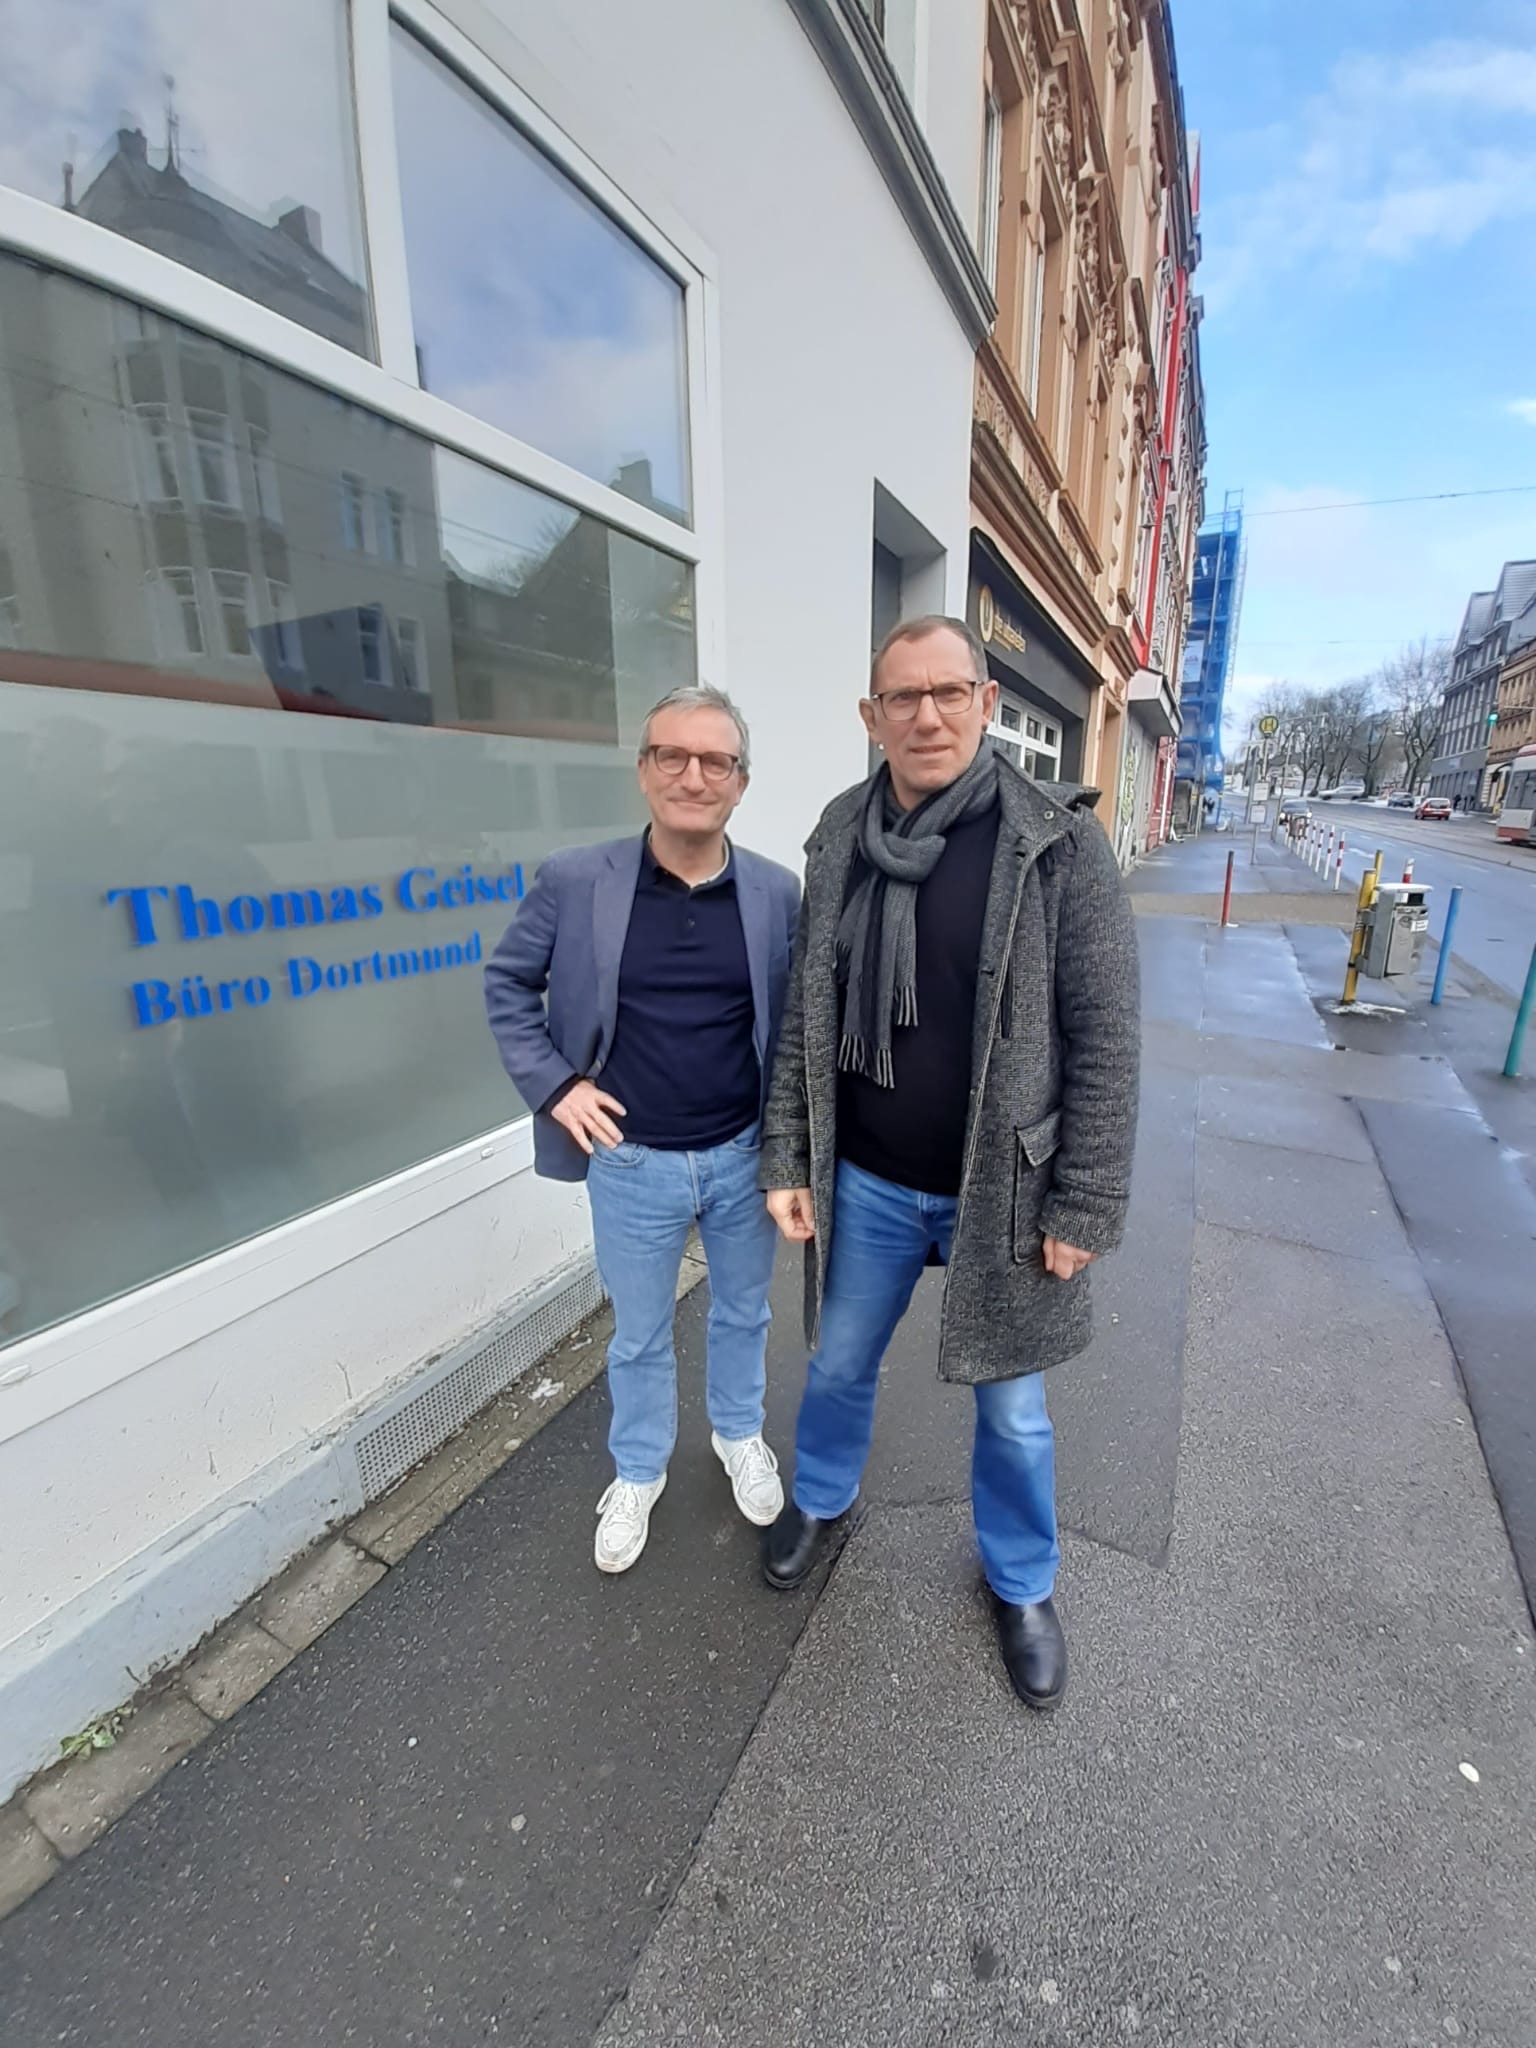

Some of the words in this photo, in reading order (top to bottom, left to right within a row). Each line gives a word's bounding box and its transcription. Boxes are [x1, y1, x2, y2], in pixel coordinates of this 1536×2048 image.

[106, 884, 384, 947] Thomas
[397, 863, 525, 912] Geisel
[131, 975, 271, 1028] Büro
[287, 930, 482, 999] Dortmund
